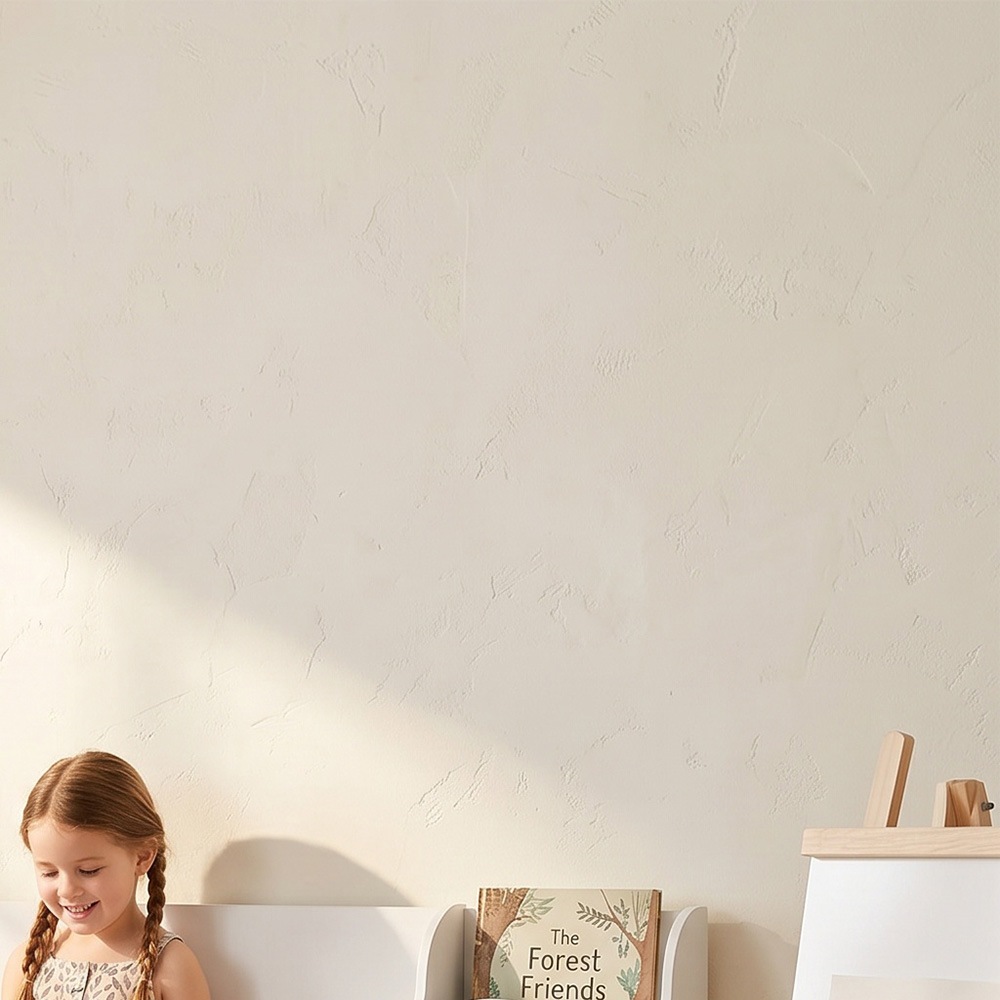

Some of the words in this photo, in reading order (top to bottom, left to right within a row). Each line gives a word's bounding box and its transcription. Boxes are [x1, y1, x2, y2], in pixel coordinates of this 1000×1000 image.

[551, 929, 580, 945] The
[528, 947, 602, 972] Forest
[521, 975, 606, 1000] Friends
